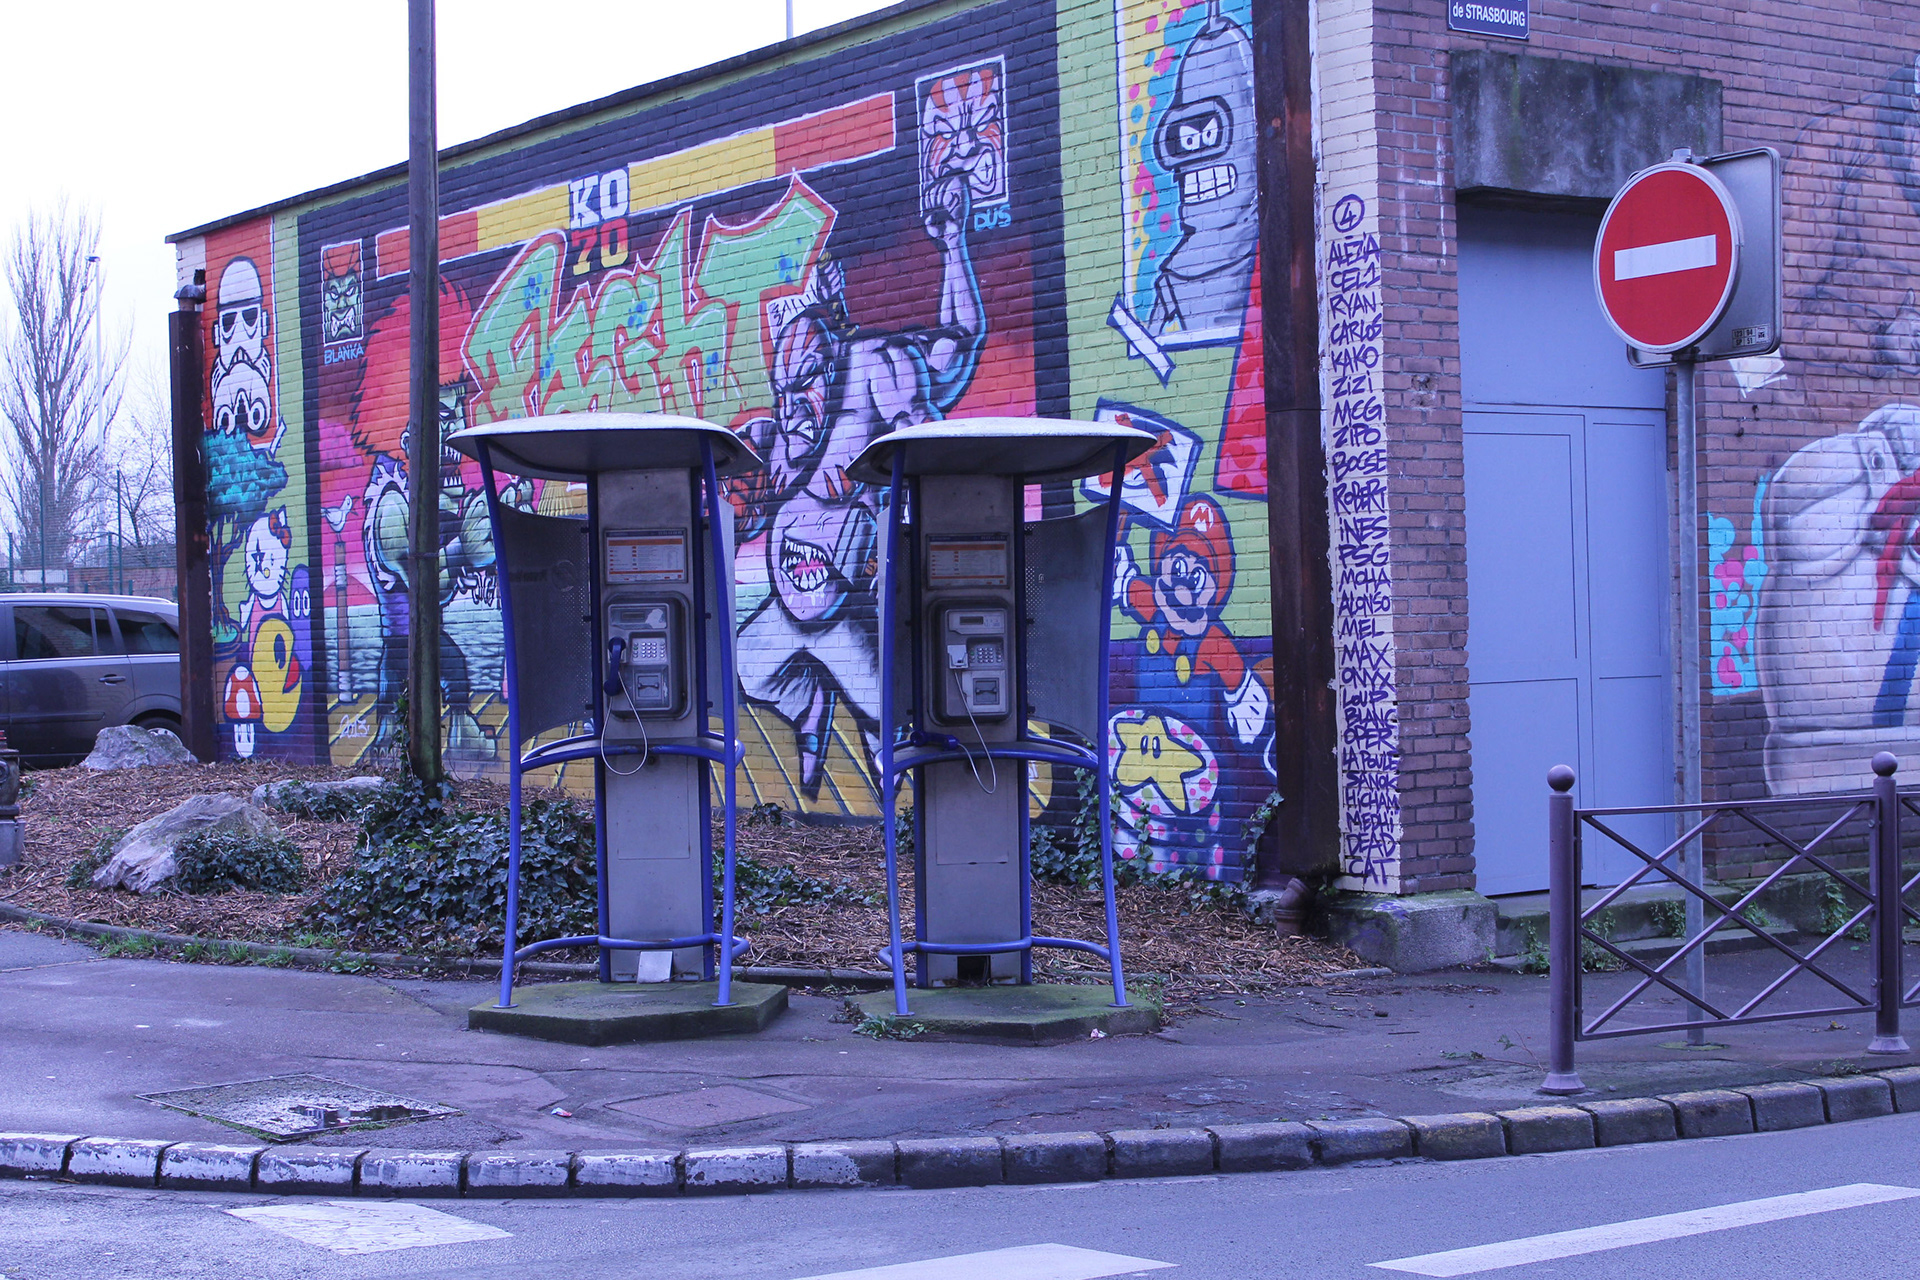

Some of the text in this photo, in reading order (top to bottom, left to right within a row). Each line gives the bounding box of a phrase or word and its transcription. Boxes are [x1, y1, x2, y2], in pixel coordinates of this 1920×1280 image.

[1452, 2, 1526, 27] de STRASBOURG
[570, 169, 629, 231] KO
[571, 218, 629, 276] 70
[1330, 292, 1376, 319] RYAN
[324, 342, 364, 366] BLANKA
[1331, 343, 1379, 374] KAKO
[1333, 397, 1381, 427] MCG
[1338, 543, 1388, 568] PSG
[1339, 567, 1390, 593] MOHA
[1339, 590, 1391, 617] ALONSO
[1339, 618, 1384, 641] MEL
[1341, 640, 1393, 669] MAX
[1341, 665, 1395, 693] ONYX
[1342, 747, 1359, 772] LA
[1346, 830, 1396, 859] DEAD
[1348, 859, 1395, 886] CAT
